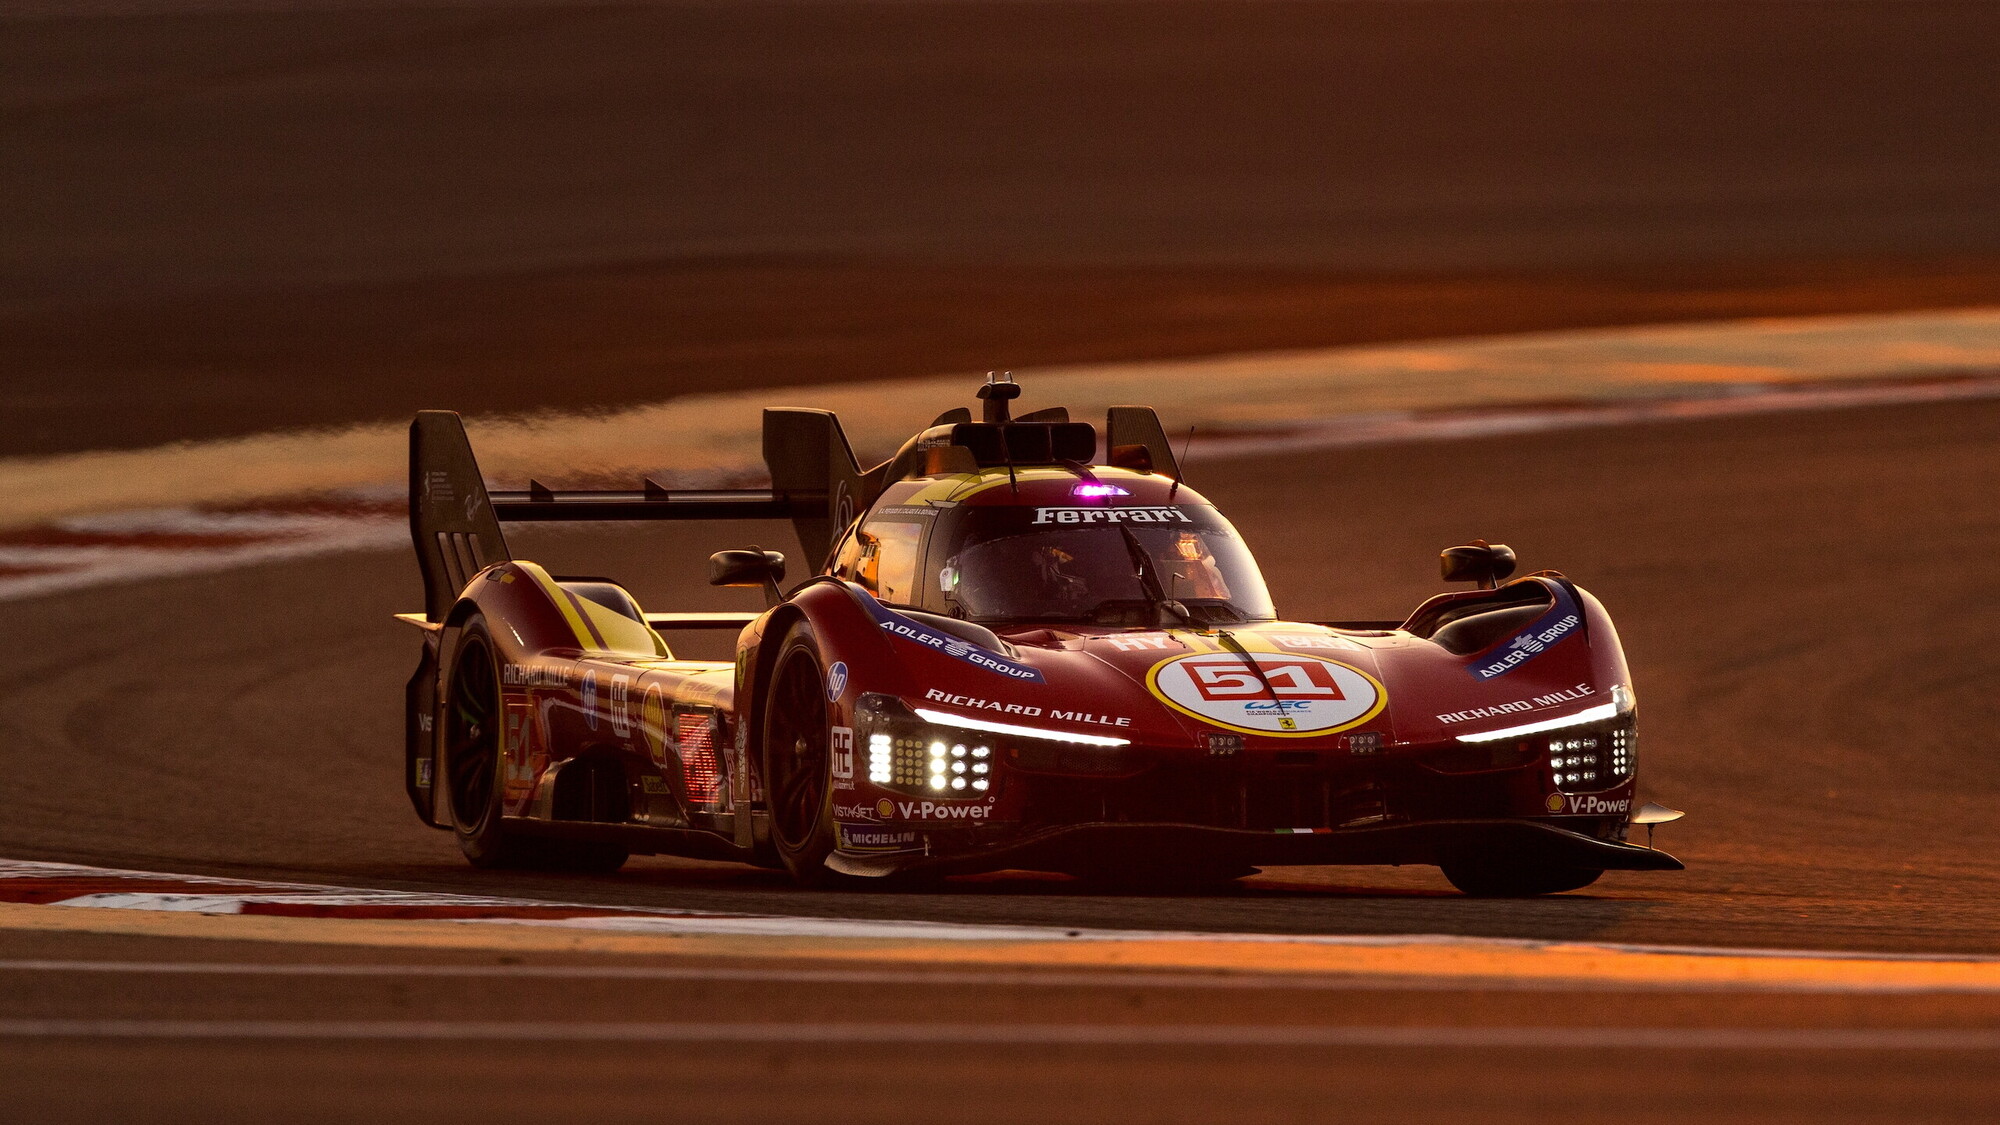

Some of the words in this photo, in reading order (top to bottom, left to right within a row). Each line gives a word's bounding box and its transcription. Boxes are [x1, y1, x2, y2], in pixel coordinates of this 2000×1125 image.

[1032, 506, 1192, 524] Ferrari
[880, 620, 943, 650] ADLER
[967, 652, 1035, 680] GROUP
[1107, 636, 1168, 651] HY
[1479, 649, 1528, 678] ADLER
[1539, 614, 1579, 643] GROUP
[504, 664, 542, 686] RICHARD
[543, 664, 570, 686] MILLE
[828, 663, 846, 700] hp
[1193, 664, 1335, 696] 51
[925, 688, 1042, 717] RICHARD
[1050, 709, 1132, 727] MILLE
[1245, 700, 1312, 709] WEC
[1437, 701, 1533, 725] RICHARD
[1532, 682, 1596, 708] MILLE
[898, 801, 993, 820] V-Power
[1569, 795, 1630, 814] V-Power
[852, 831, 916, 845] MICHELIN
